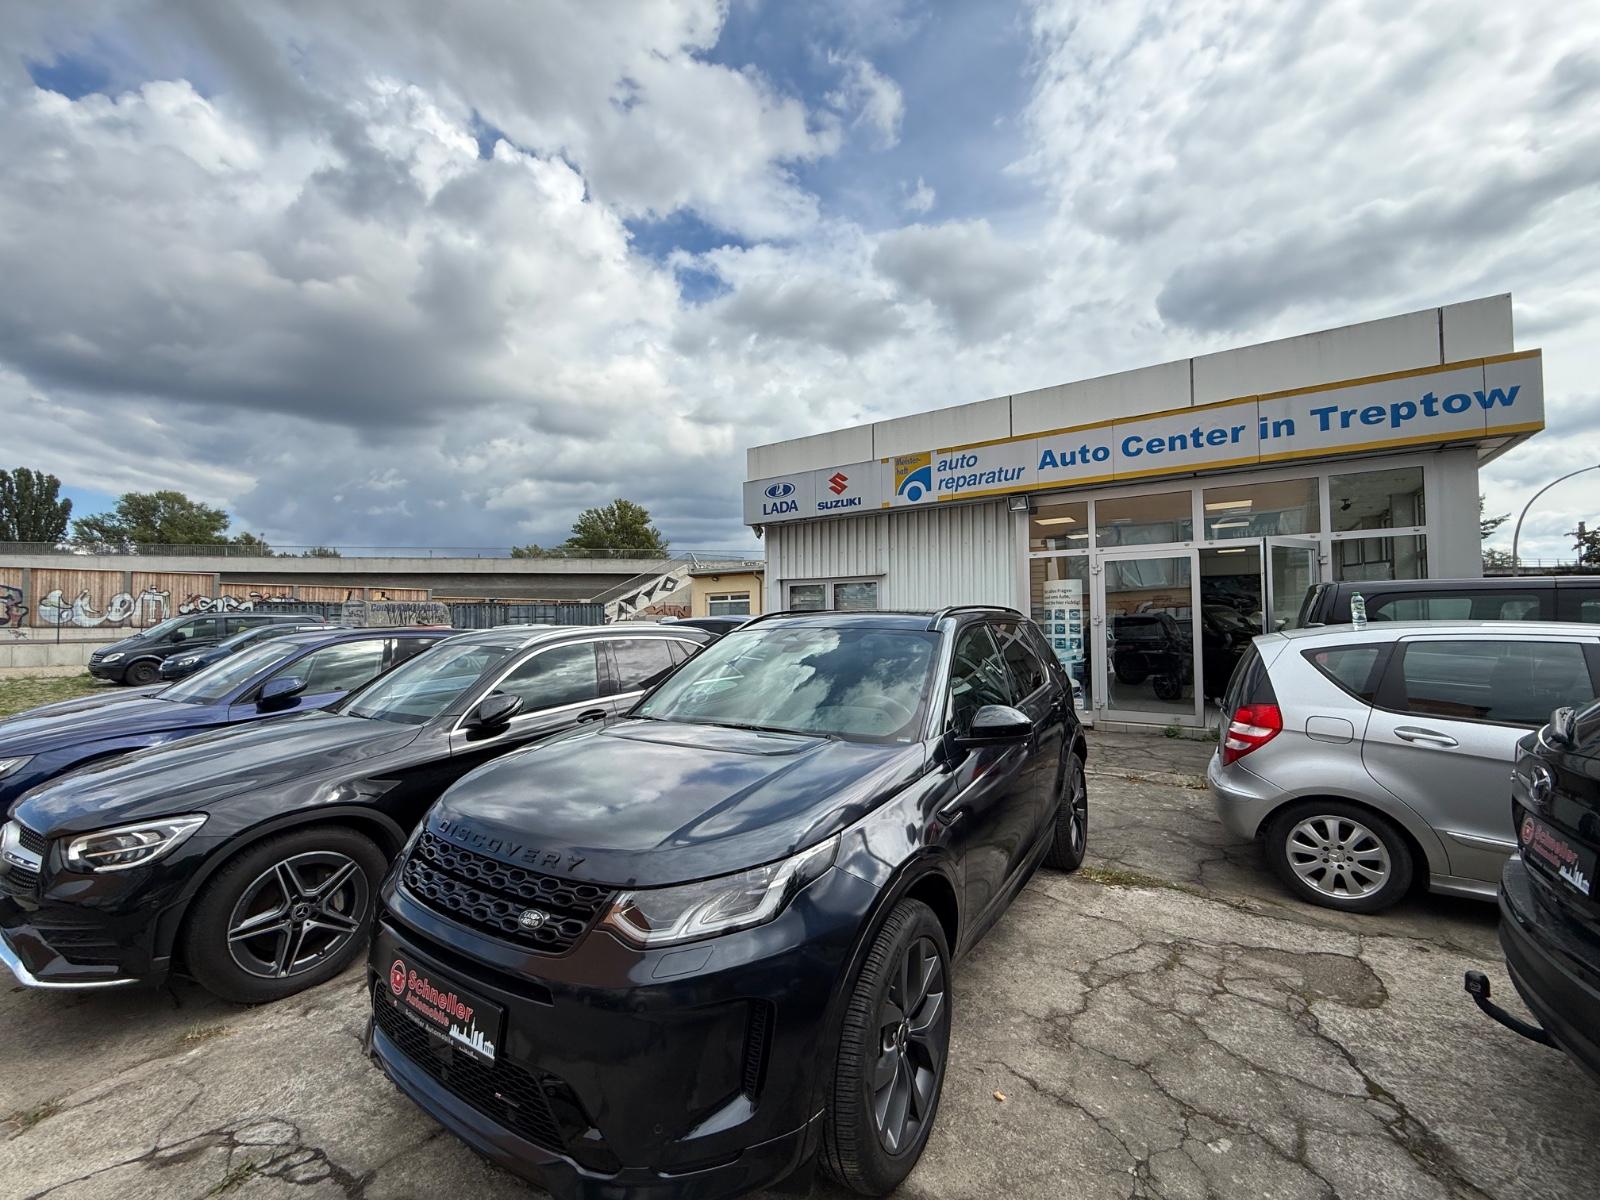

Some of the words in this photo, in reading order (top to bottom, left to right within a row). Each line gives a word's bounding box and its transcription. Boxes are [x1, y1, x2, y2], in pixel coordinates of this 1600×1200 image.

[1038, 444, 1110, 470] Auto
[1121, 424, 1246, 458] Center
[1259, 416, 1295, 440] in
[1310, 385, 1521, 432] Treptow
[937, 454, 978, 472] auto
[938, 466, 1025, 491] reparatur
[763, 500, 798, 515] LADA
[817, 497, 862, 511] SUZUKI
[438, 820, 586, 872] DISCOVERY
[408, 970, 474, 1022] Schneller
